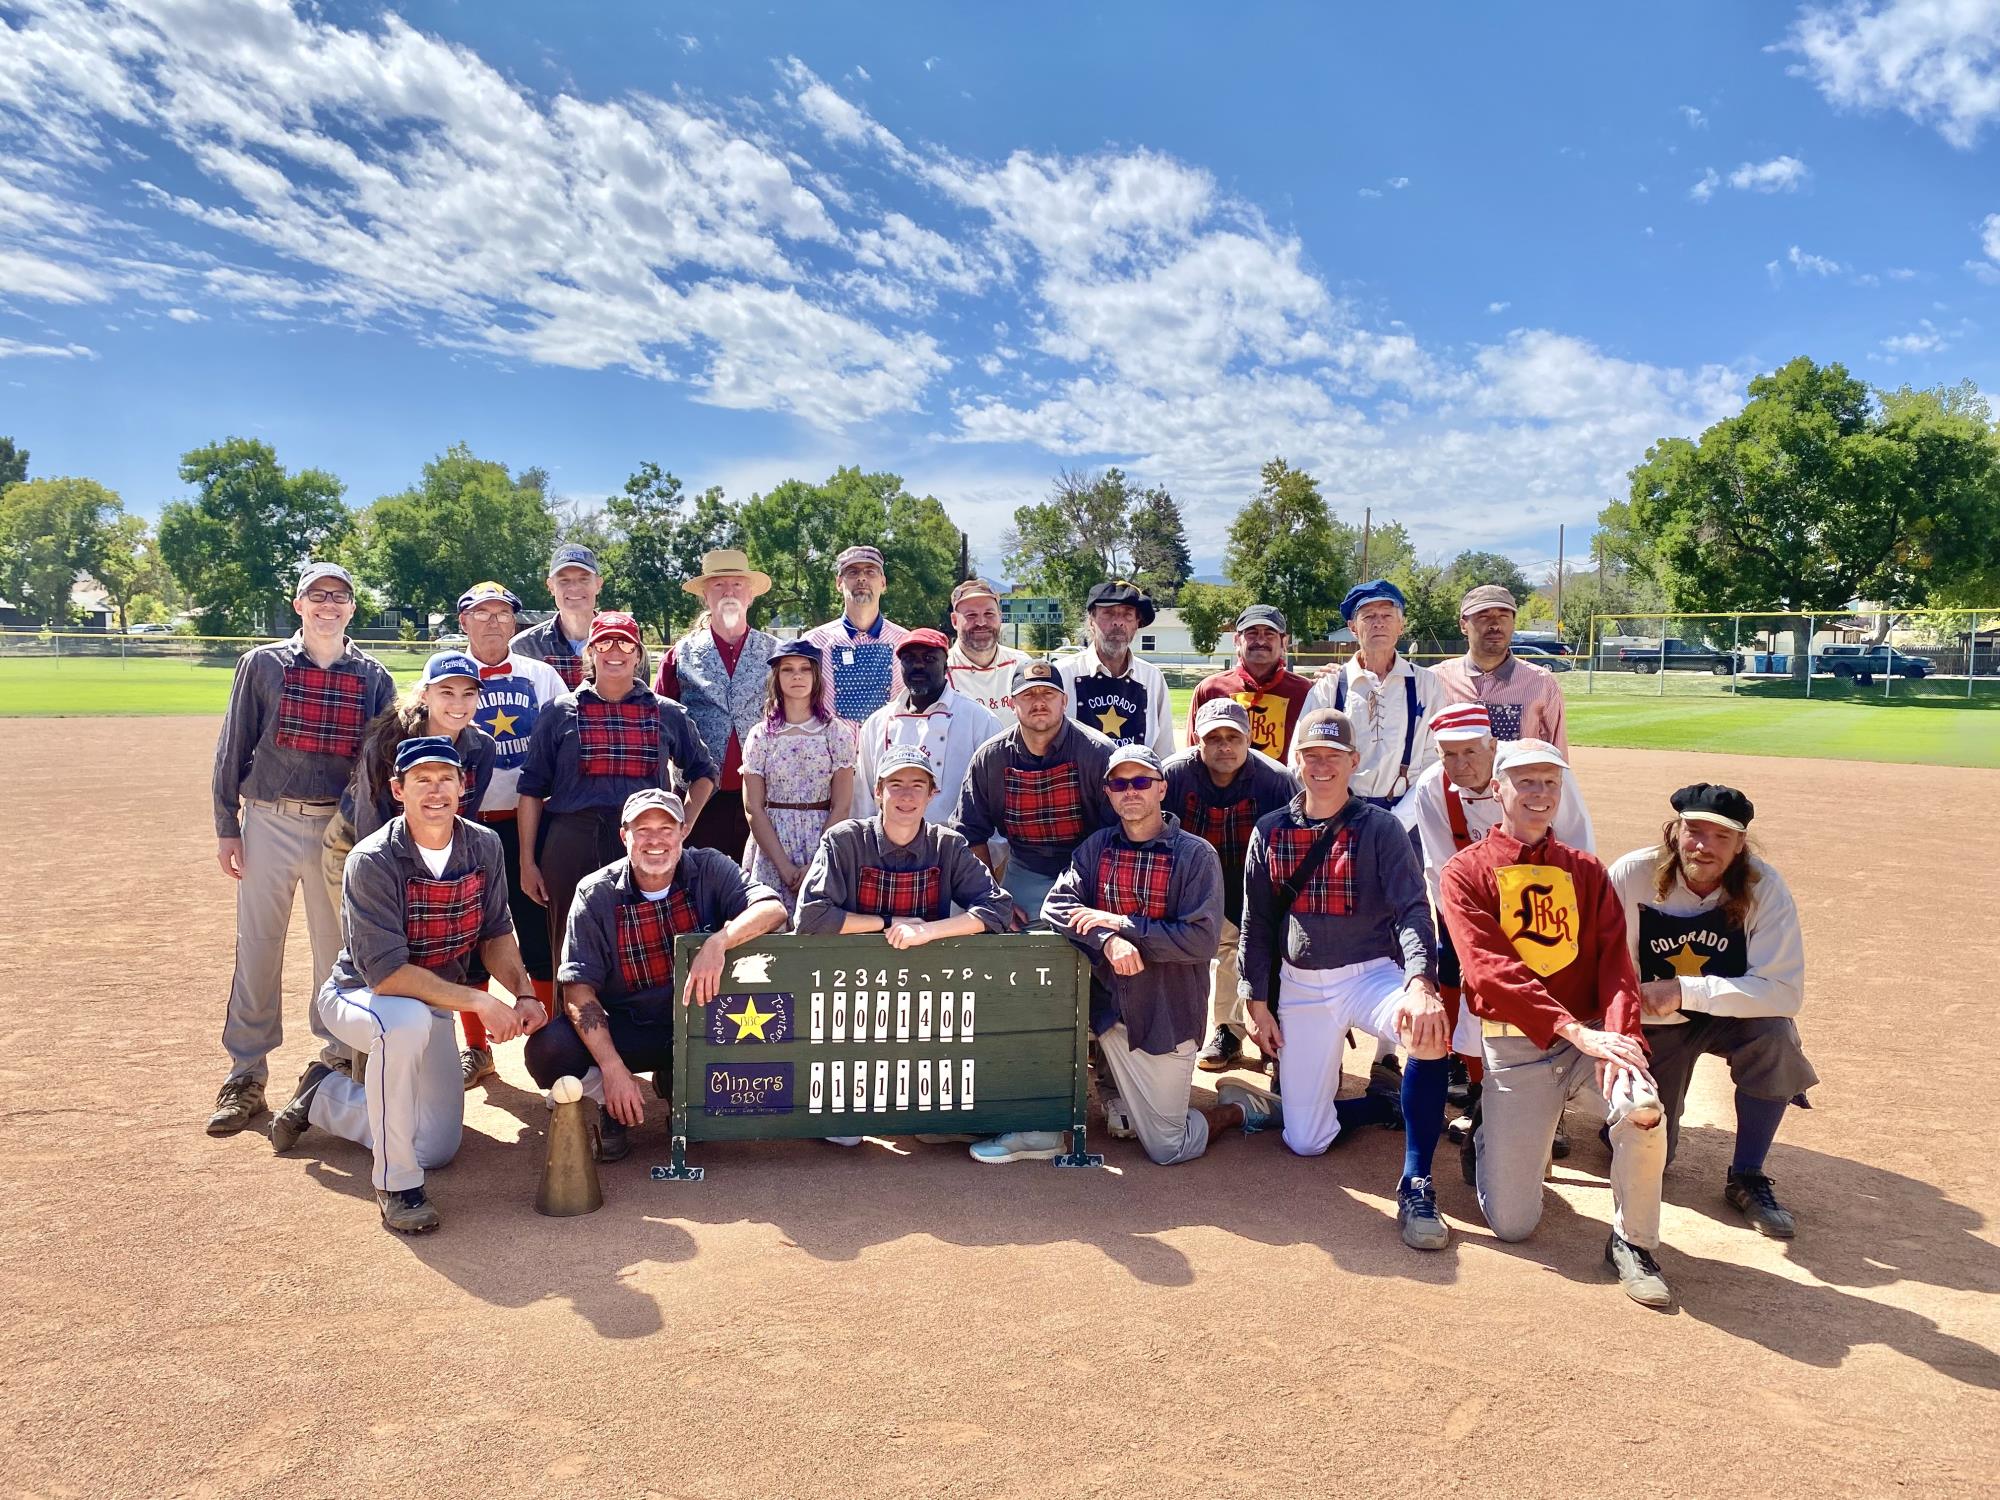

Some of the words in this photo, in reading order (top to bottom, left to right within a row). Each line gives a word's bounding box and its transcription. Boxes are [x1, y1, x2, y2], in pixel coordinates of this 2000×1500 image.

[990, 698, 998, 709] &
[1088, 694, 1137, 714] COLORADO
[1307, 728, 1339, 737] MINERS
[1650, 929, 1729, 954] COLORADO
[811, 970, 821, 987] 1
[833, 970, 846, 987] 2
[855, 969, 868, 987] 3
[875, 969, 888, 986] 4
[897, 969, 909, 987] 5
[713, 996, 733, 1044] Colorado
[740, 1016, 761, 1027] BBC
[814, 1010, 821, 1028] 1
[835, 1009, 844, 1027] 0
[856, 1009, 865, 1027] 0
[878, 1009, 886, 1027] 0
[900, 1010, 907, 1027] 1
[920, 1008, 929, 1026] 4
[943, 1010, 951, 1028] 0
[963, 1009, 972, 1027] 0
[711, 1071, 783, 1093] Miners
[812, 1080, 820, 1098] 0
[835, 1079, 842, 1097] 1
[855, 1079, 865, 1097] 5
[878, 1077, 885, 1095] 1
[899, 1077, 906, 1095] 1
[921, 1078, 929, 1096] 0
[941, 1077, 950, 1095] 4
[964, 1077, 971, 1095] 1
[731, 1091, 765, 1104] BBC
[1246, 1093, 1271, 1115] N
